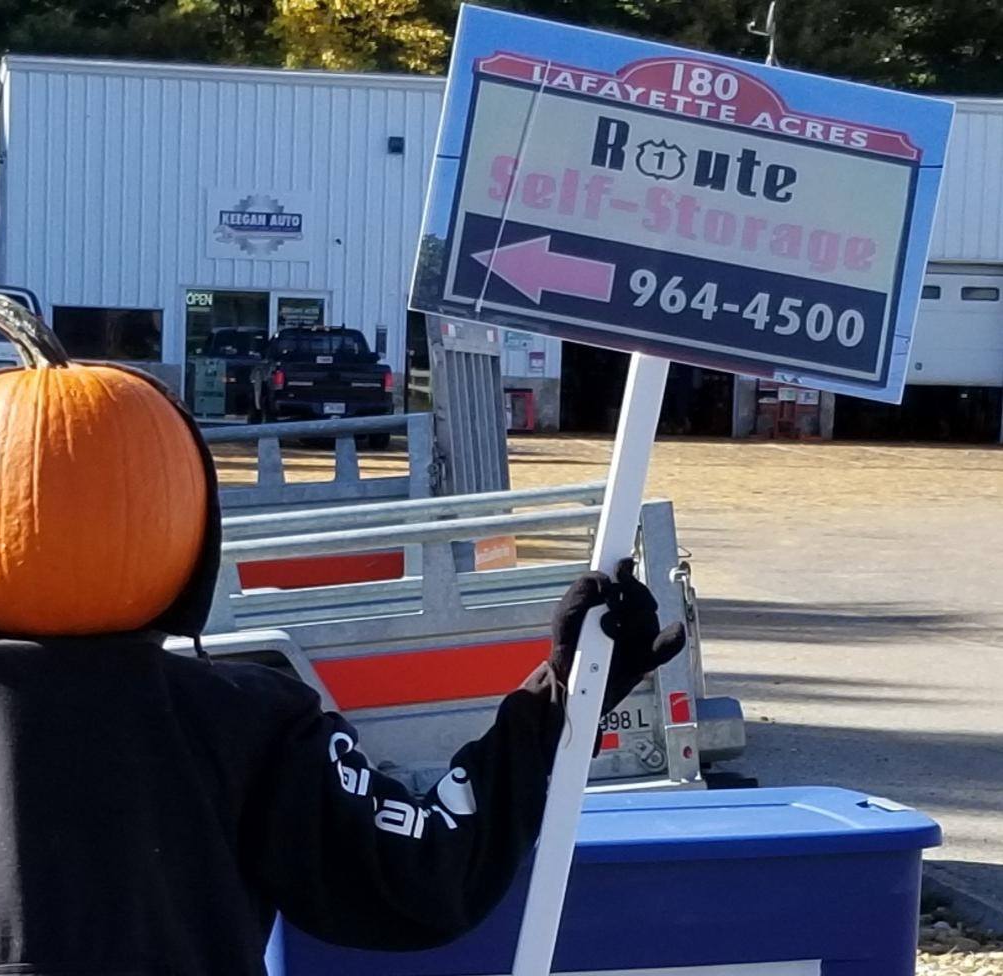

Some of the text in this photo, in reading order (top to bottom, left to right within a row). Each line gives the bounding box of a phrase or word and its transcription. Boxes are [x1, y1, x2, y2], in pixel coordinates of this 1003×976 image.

[531, 65, 869, 149] LAFAYETTE ACRES
[671, 62, 739, 102] 180
[221, 212, 300, 227] KEEGAN AUTO
[487, 154, 879, 274] Self-Storage
[186, 292, 214, 306] OPEN
[628, 268, 866, 348] 964-4500
